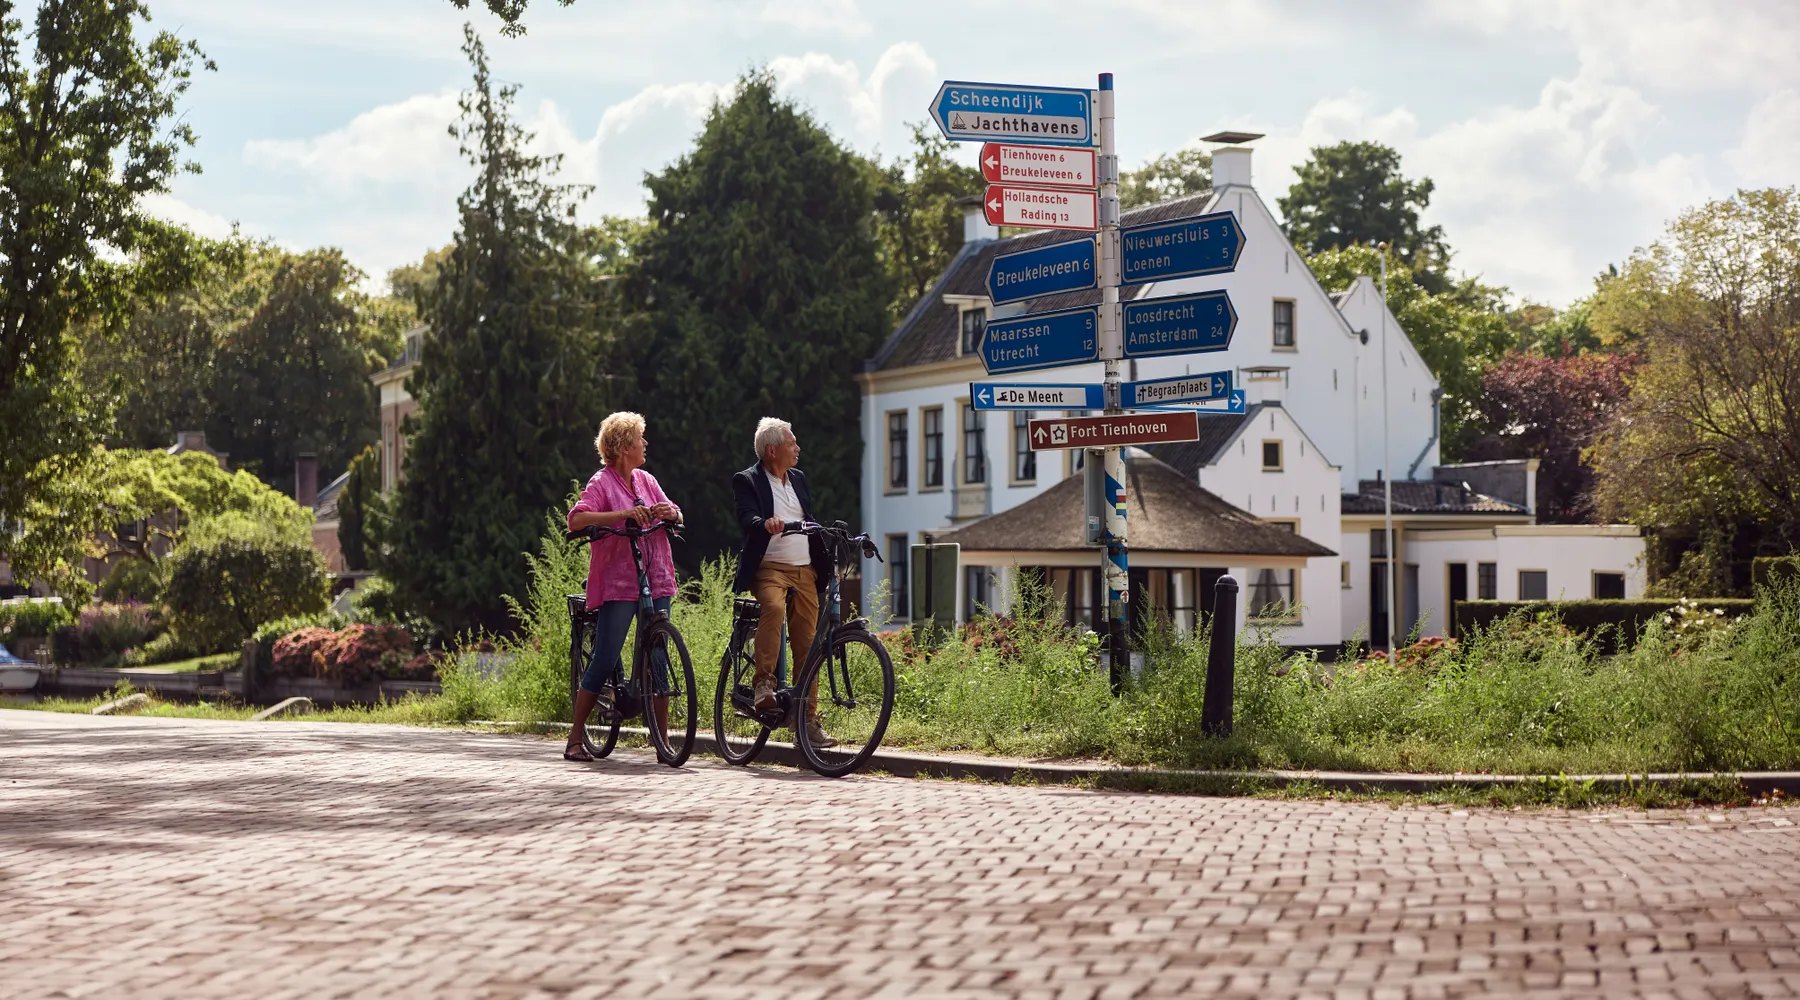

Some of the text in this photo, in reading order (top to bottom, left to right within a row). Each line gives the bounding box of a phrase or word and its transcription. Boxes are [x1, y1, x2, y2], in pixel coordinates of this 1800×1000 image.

[950, 90, 1083, 113] Scheendijk 1
[971, 115, 1079, 135] Jachthavens
[1001, 148, 1065, 162] Tienhoven 6
[1002, 165, 1082, 180] Breukeleveen 6
[1004, 190, 1068, 205] Hollandsche
[1021, 208, 1069, 223] Rading 13
[1125, 225, 1228, 252] Nieuwersluis 3
[1126, 247, 1229, 272] Loenen 5
[996, 258, 1090, 287] Breukeleveen 6
[1128, 303, 1223, 325] Loosdrecht 9
[990, 318, 1093, 343] Maarssen 5
[1128, 325, 1223, 346] Amsterdam 24
[991, 339, 1093, 362] Utrecht 12
[1009, 390, 1064, 403] De Meent
[1147, 381, 1208, 399] Begraafplaats
[1070, 421, 1168, 438] Fort Tienhoven
